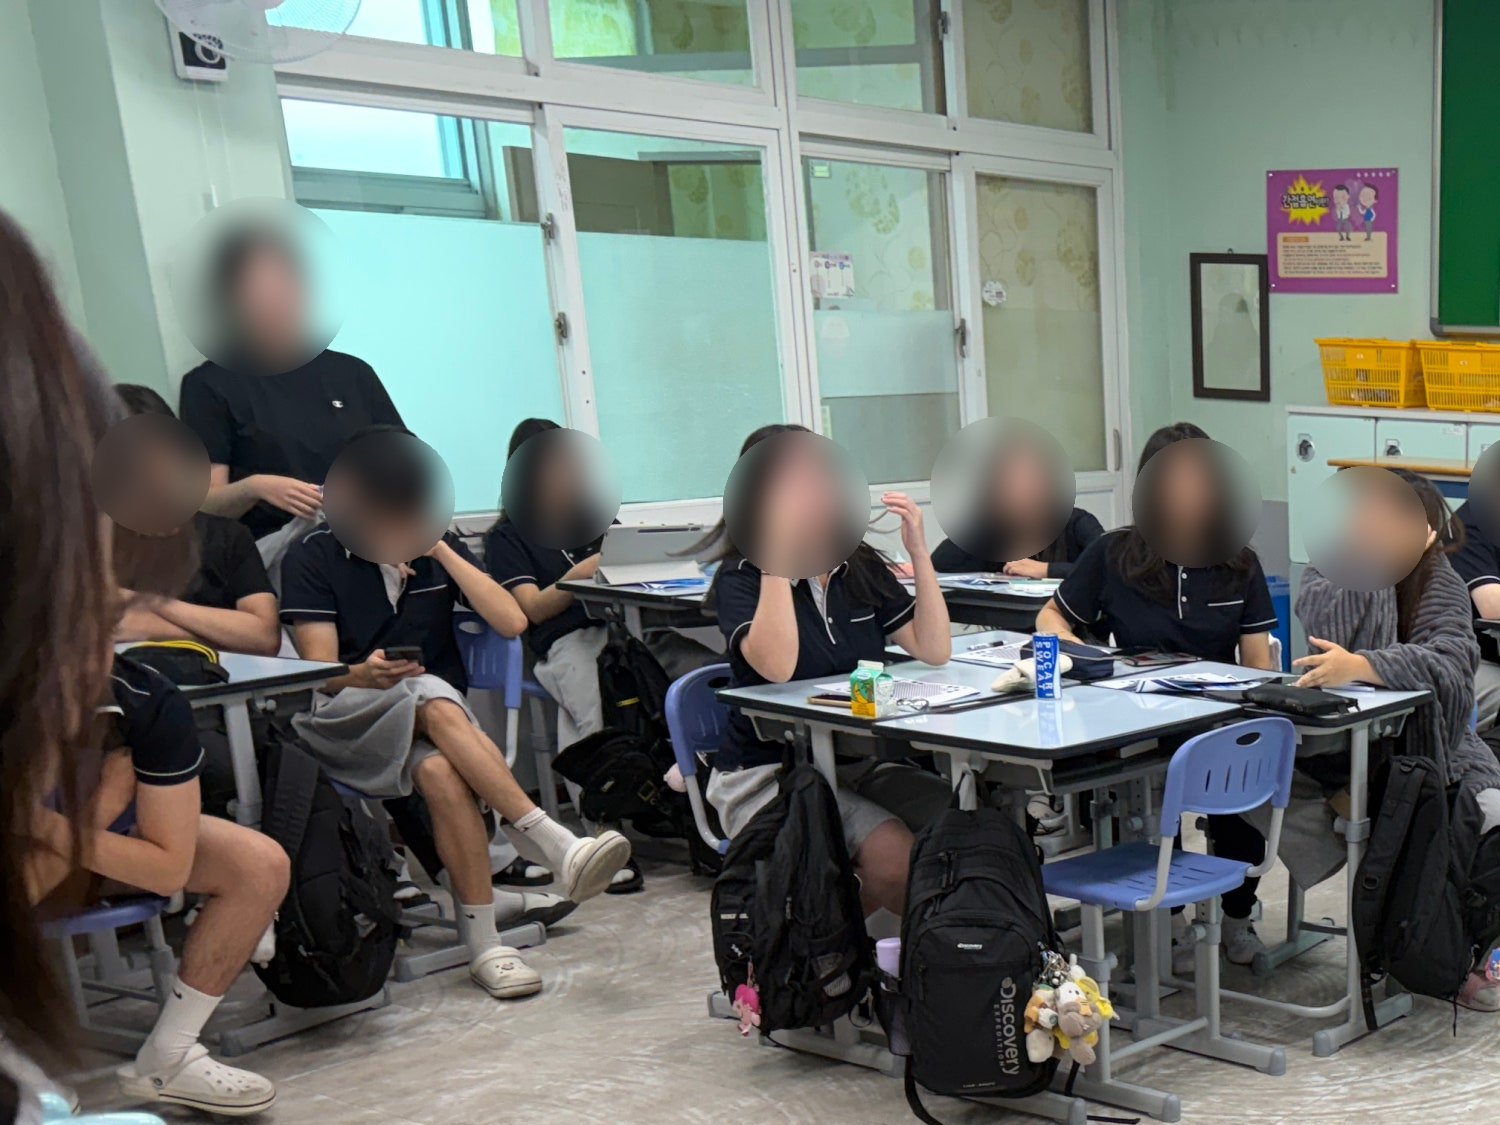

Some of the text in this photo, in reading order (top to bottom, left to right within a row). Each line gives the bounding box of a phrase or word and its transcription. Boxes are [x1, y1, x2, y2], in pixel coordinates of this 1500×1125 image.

[1036, 641, 1046, 691] SWEAT
[1043, 641, 1054, 697] POCARI
[993, 1004, 1006, 1067] EXPEDITION
